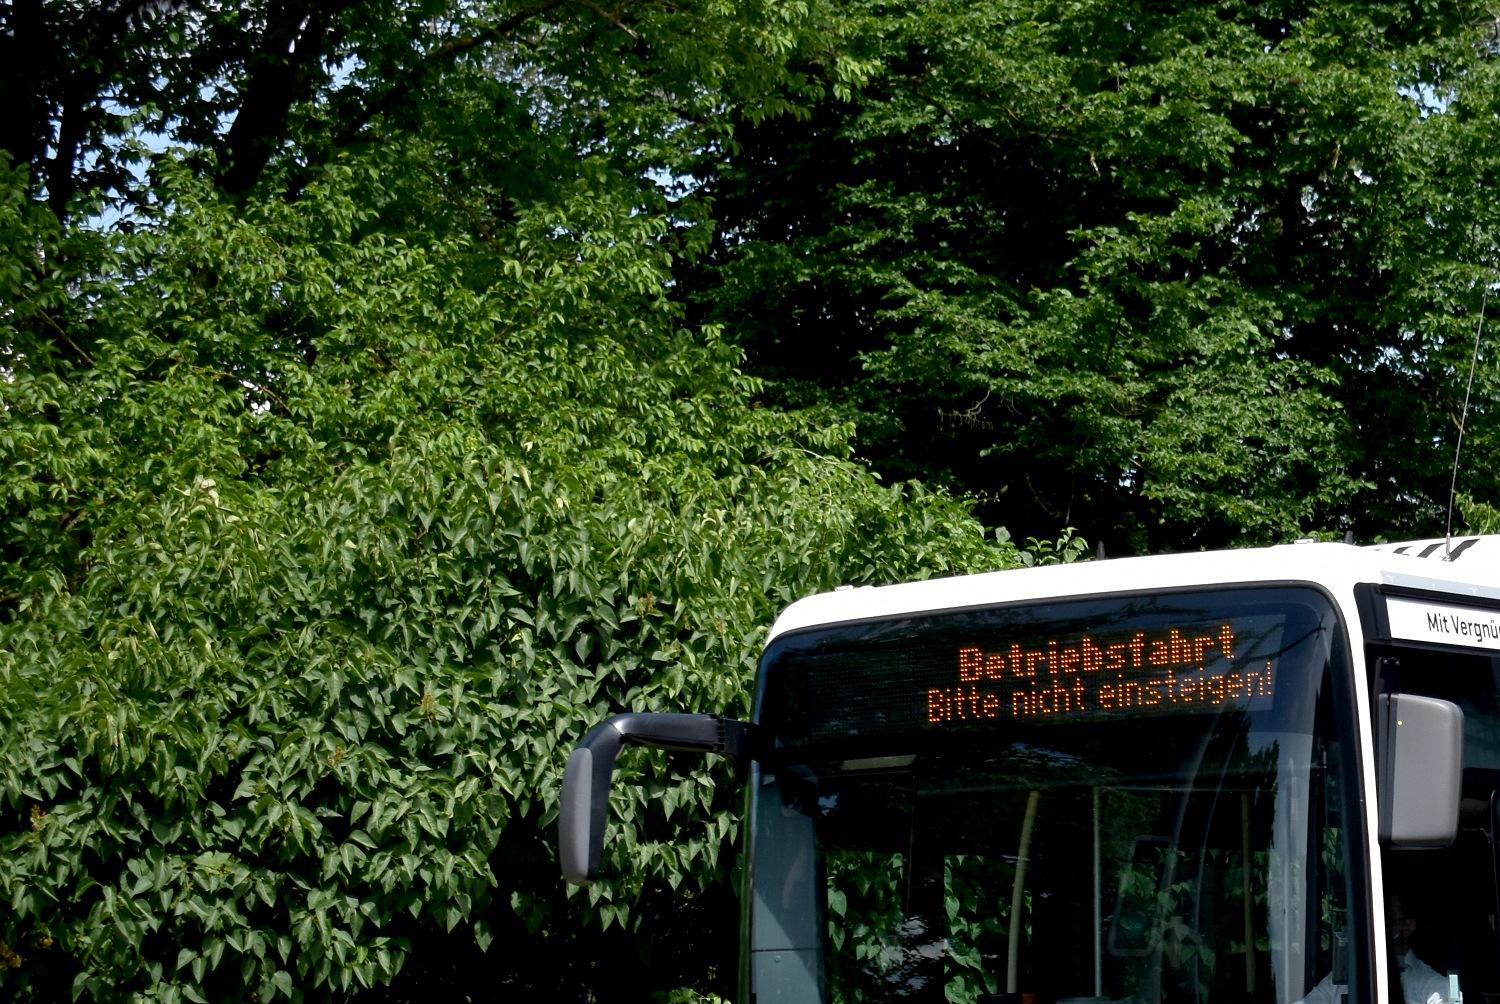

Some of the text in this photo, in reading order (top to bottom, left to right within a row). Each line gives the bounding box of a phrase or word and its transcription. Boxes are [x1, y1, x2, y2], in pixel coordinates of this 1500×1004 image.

[1427, 612, 1449, 634] Mit
[959, 624, 1235, 682] Betriebsfahrt
[928, 661, 1272, 722] Bitte nicht einsteigen!
